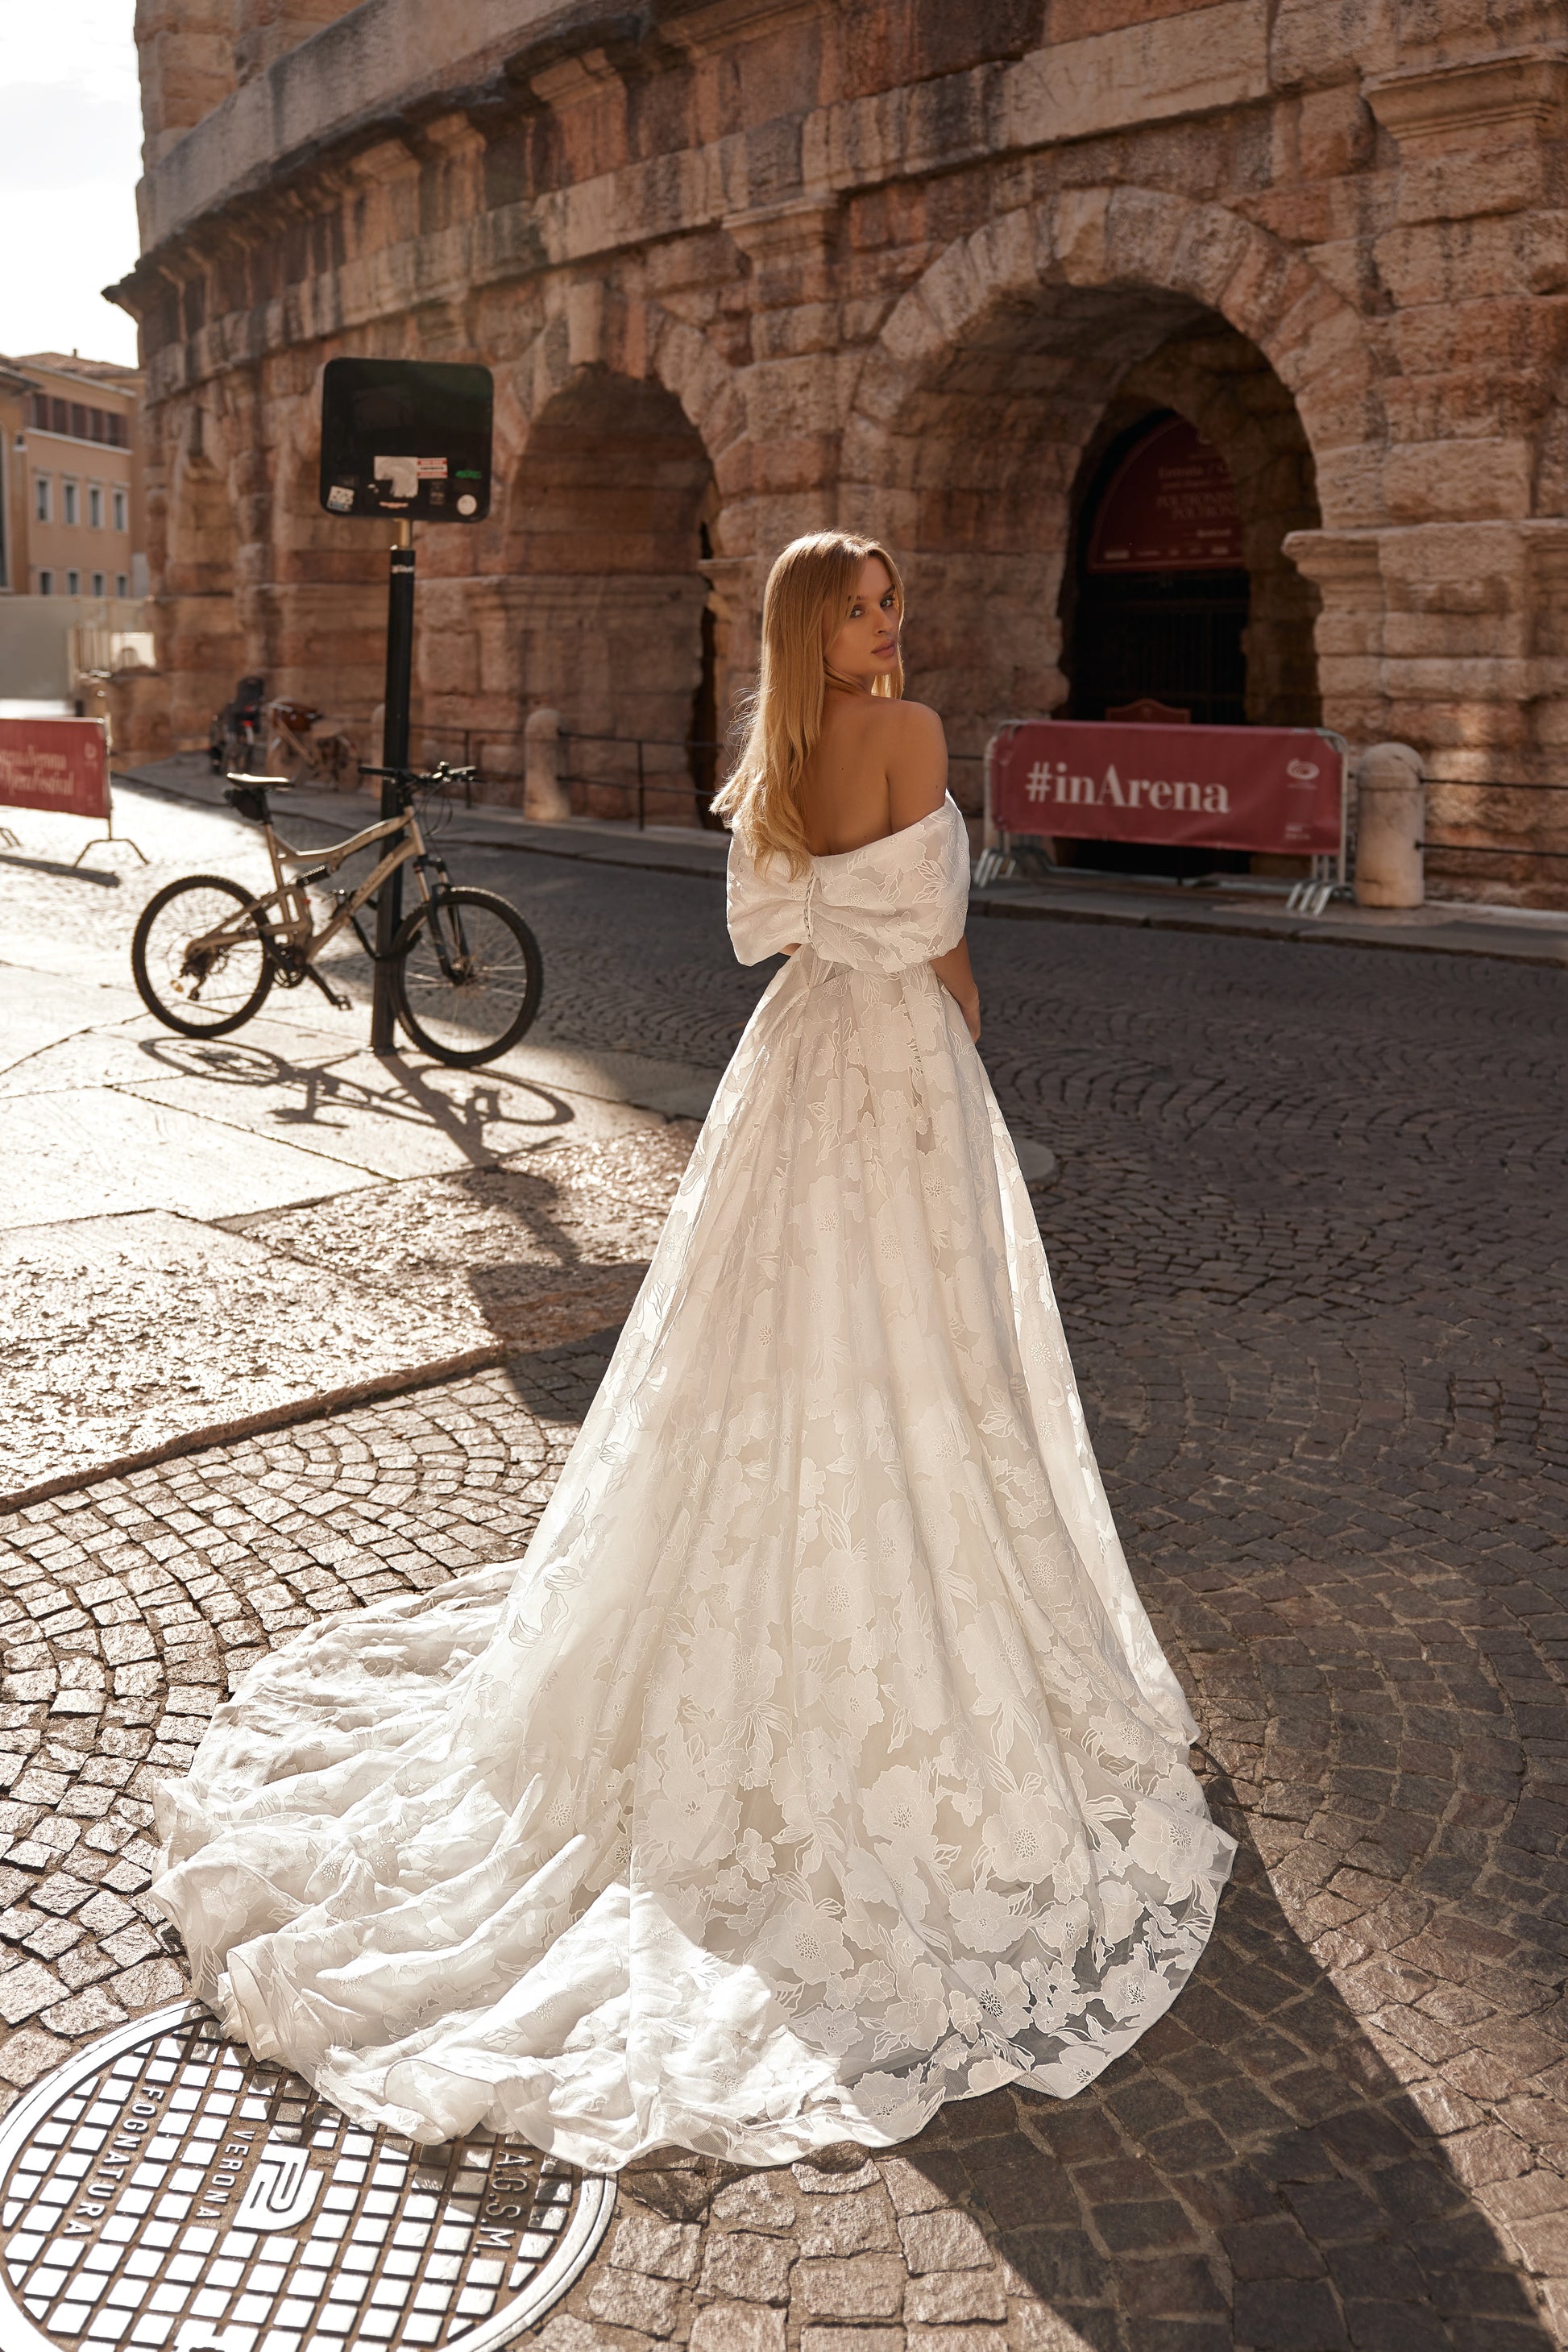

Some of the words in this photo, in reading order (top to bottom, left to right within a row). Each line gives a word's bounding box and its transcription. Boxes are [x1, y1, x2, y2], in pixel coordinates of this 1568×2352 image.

[1025, 761, 1231, 814] #inArena
[64, 2085, 165, 2236] FOGNATURA
[196, 2130, 255, 2219] VERONA
